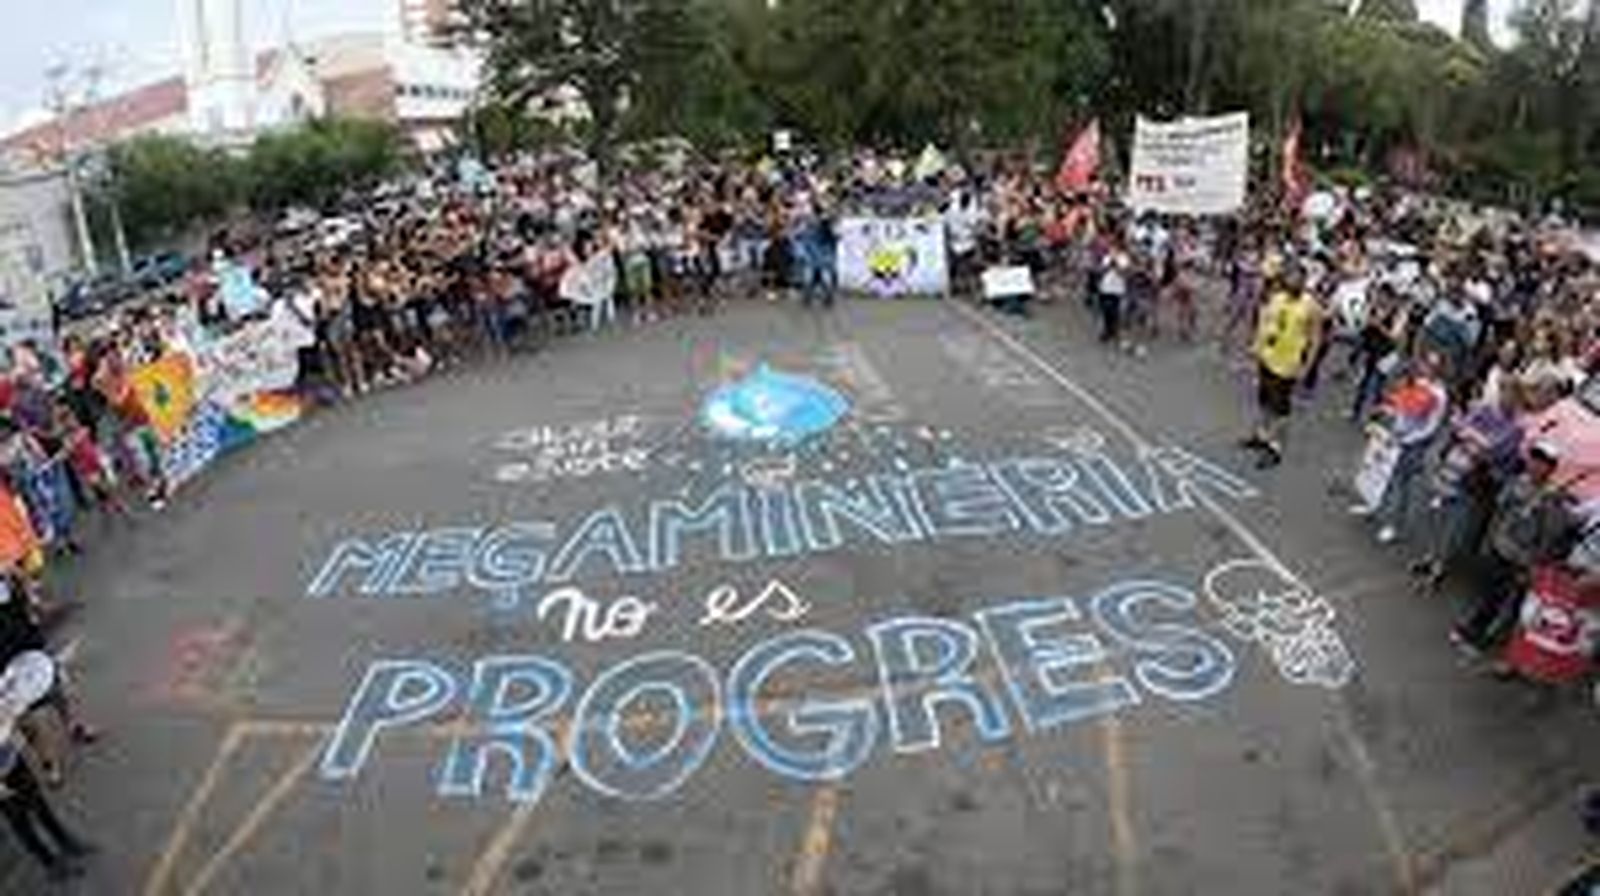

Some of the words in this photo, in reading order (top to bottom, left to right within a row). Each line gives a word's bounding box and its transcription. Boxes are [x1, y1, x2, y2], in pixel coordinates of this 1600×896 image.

[308, 447, 1257, 608] MEGAMINERIA
[537, 586, 657, 641] no
[700, 579, 811, 625] es
